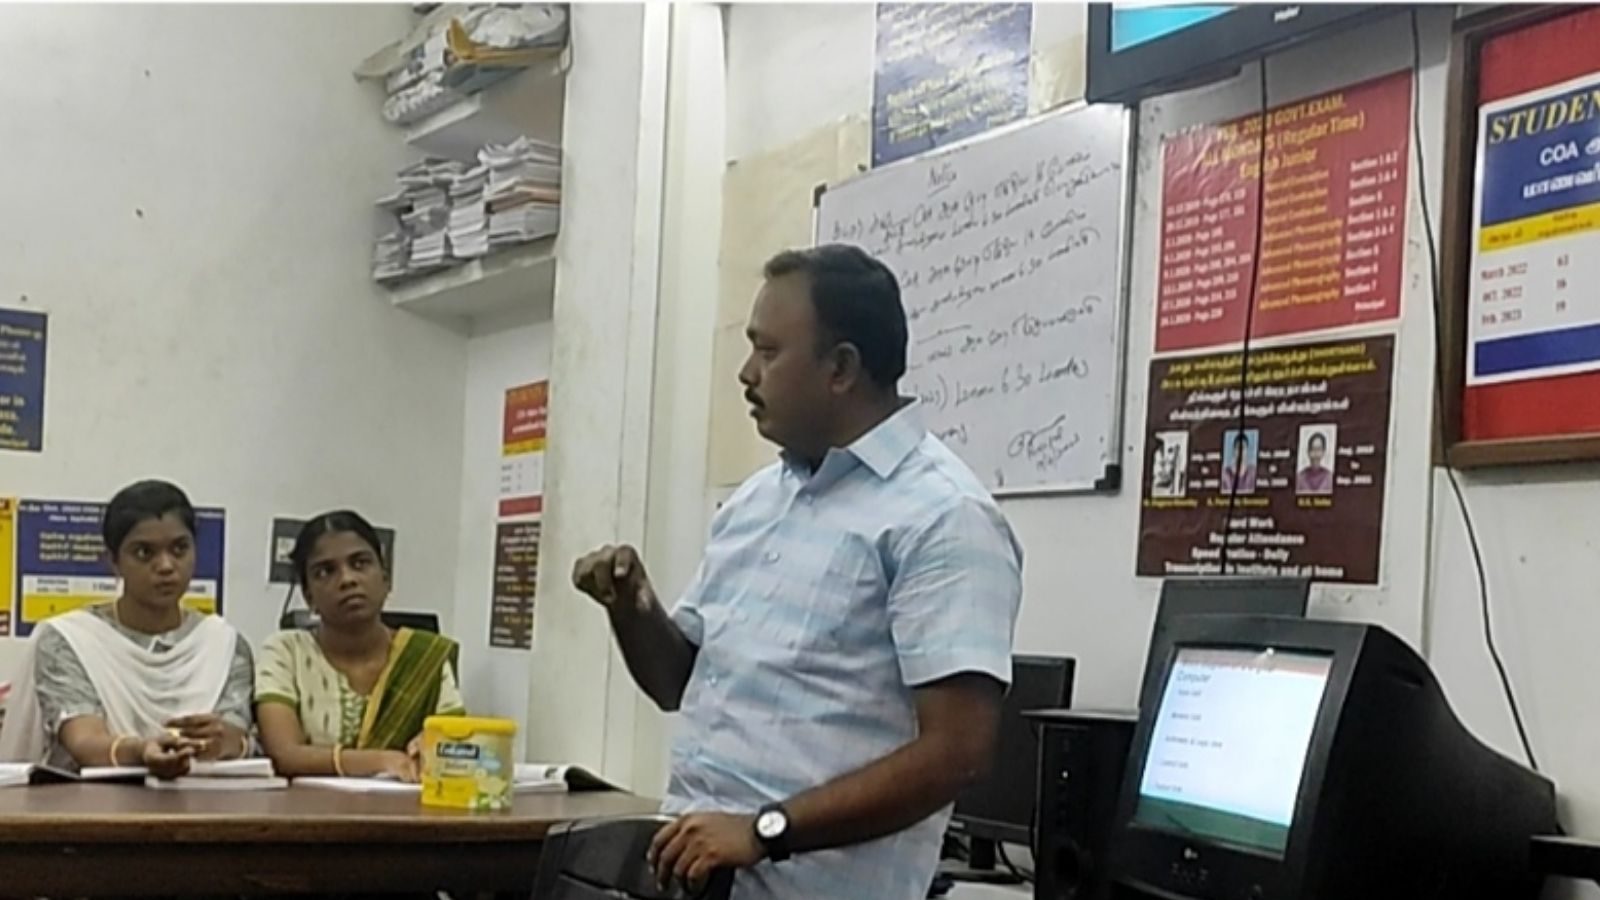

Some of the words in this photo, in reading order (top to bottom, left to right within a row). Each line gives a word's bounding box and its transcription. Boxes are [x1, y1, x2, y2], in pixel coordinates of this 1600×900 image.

[1539, 141, 1579, 166] COA
[1249, 517, 1274, 529] Work
[1248, 533, 1305, 545] Attendance
[1263, 549, 1290, 562] Daily
[1281, 565, 1299, 576] and
[1314, 565, 1344, 577] home
